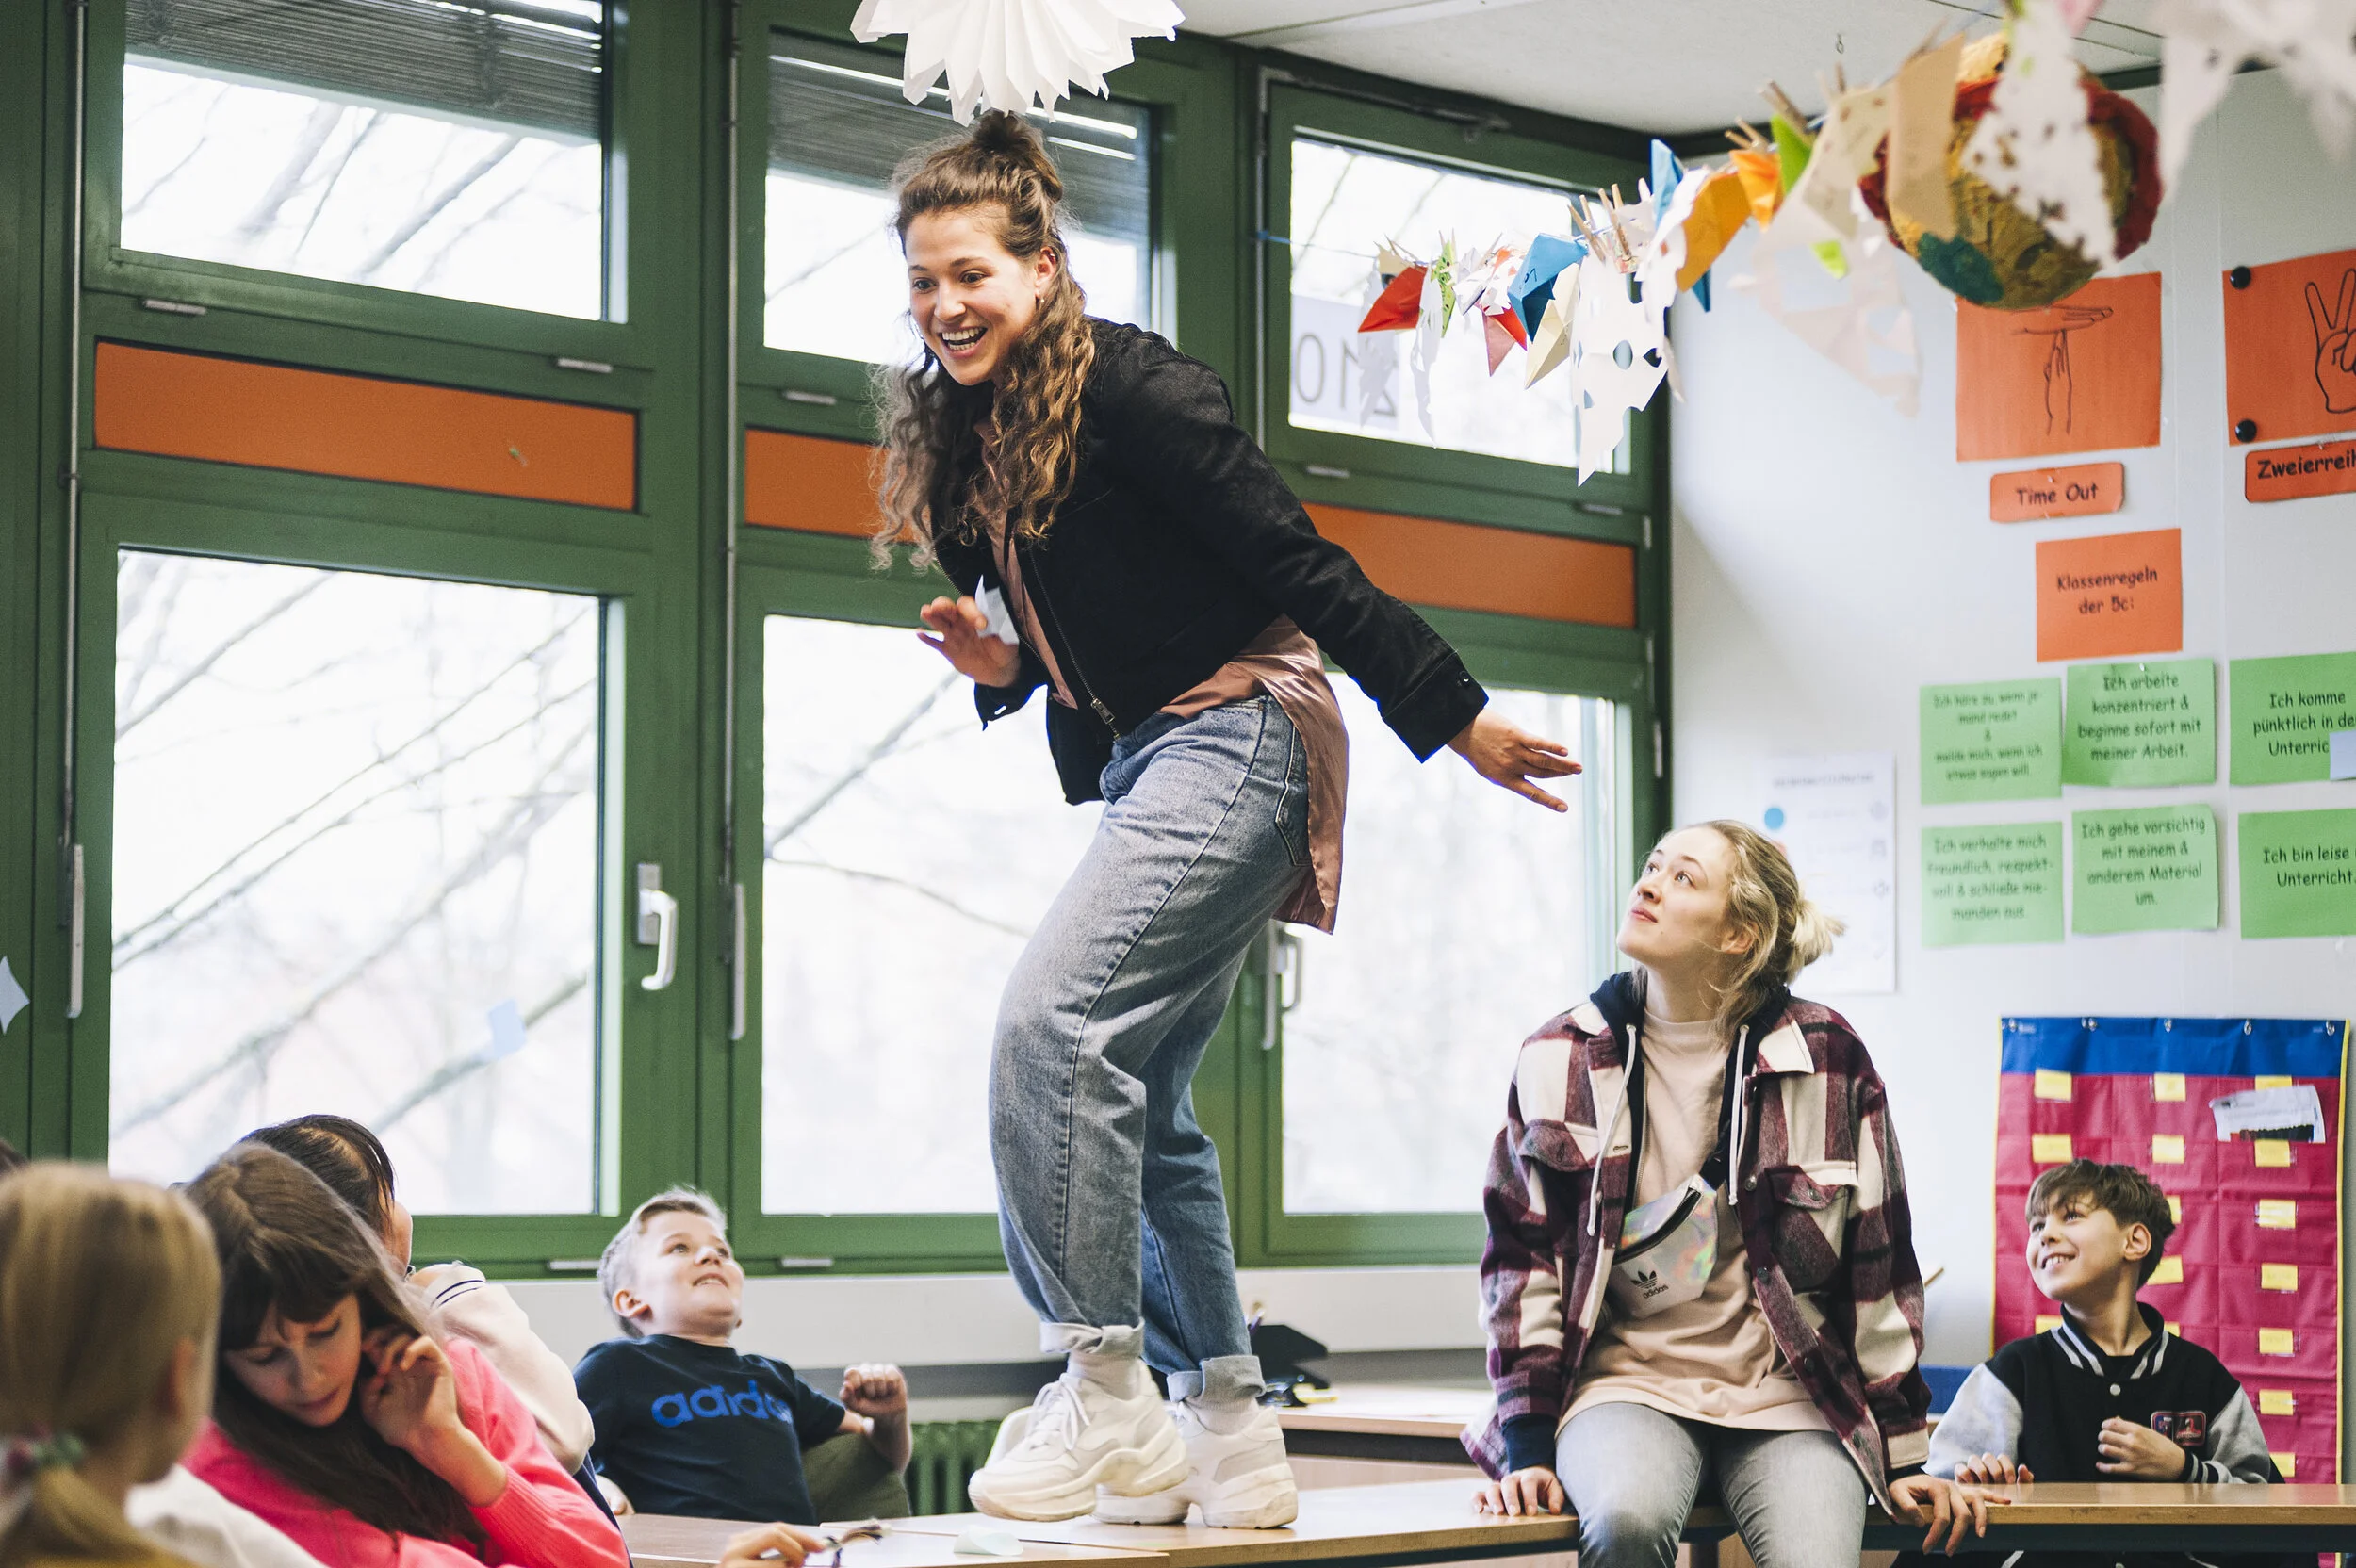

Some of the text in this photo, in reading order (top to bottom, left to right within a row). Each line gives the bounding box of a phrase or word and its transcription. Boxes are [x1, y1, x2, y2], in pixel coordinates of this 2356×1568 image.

[2016, 483, 2099, 506] Time Out
[2056, 565, 2158, 592] Klassenregeln
[2079, 597, 2104, 614] der
[2103, 671, 2179, 691] Ich arbeite
[2092, 694, 2189, 715] konzentriert &
[2269, 689, 2347, 709] Ich komme
[2077, 719, 2201, 742] beginne sofort mit
[2253, 710, 2356, 738] pünktlich in de
[2091, 743, 2188, 760] meiner Arbeit.
[2268, 736, 2330, 756] Unterric
[2082, 816, 2205, 841] Ich gehe vorsichtig
[2101, 840, 2188, 859] mit meinem &
[2263, 844, 2349, 864] Ich bin leise
[2086, 861, 2202, 884] anderem Material
[1644, 1285, 1669, 1298] adidas
